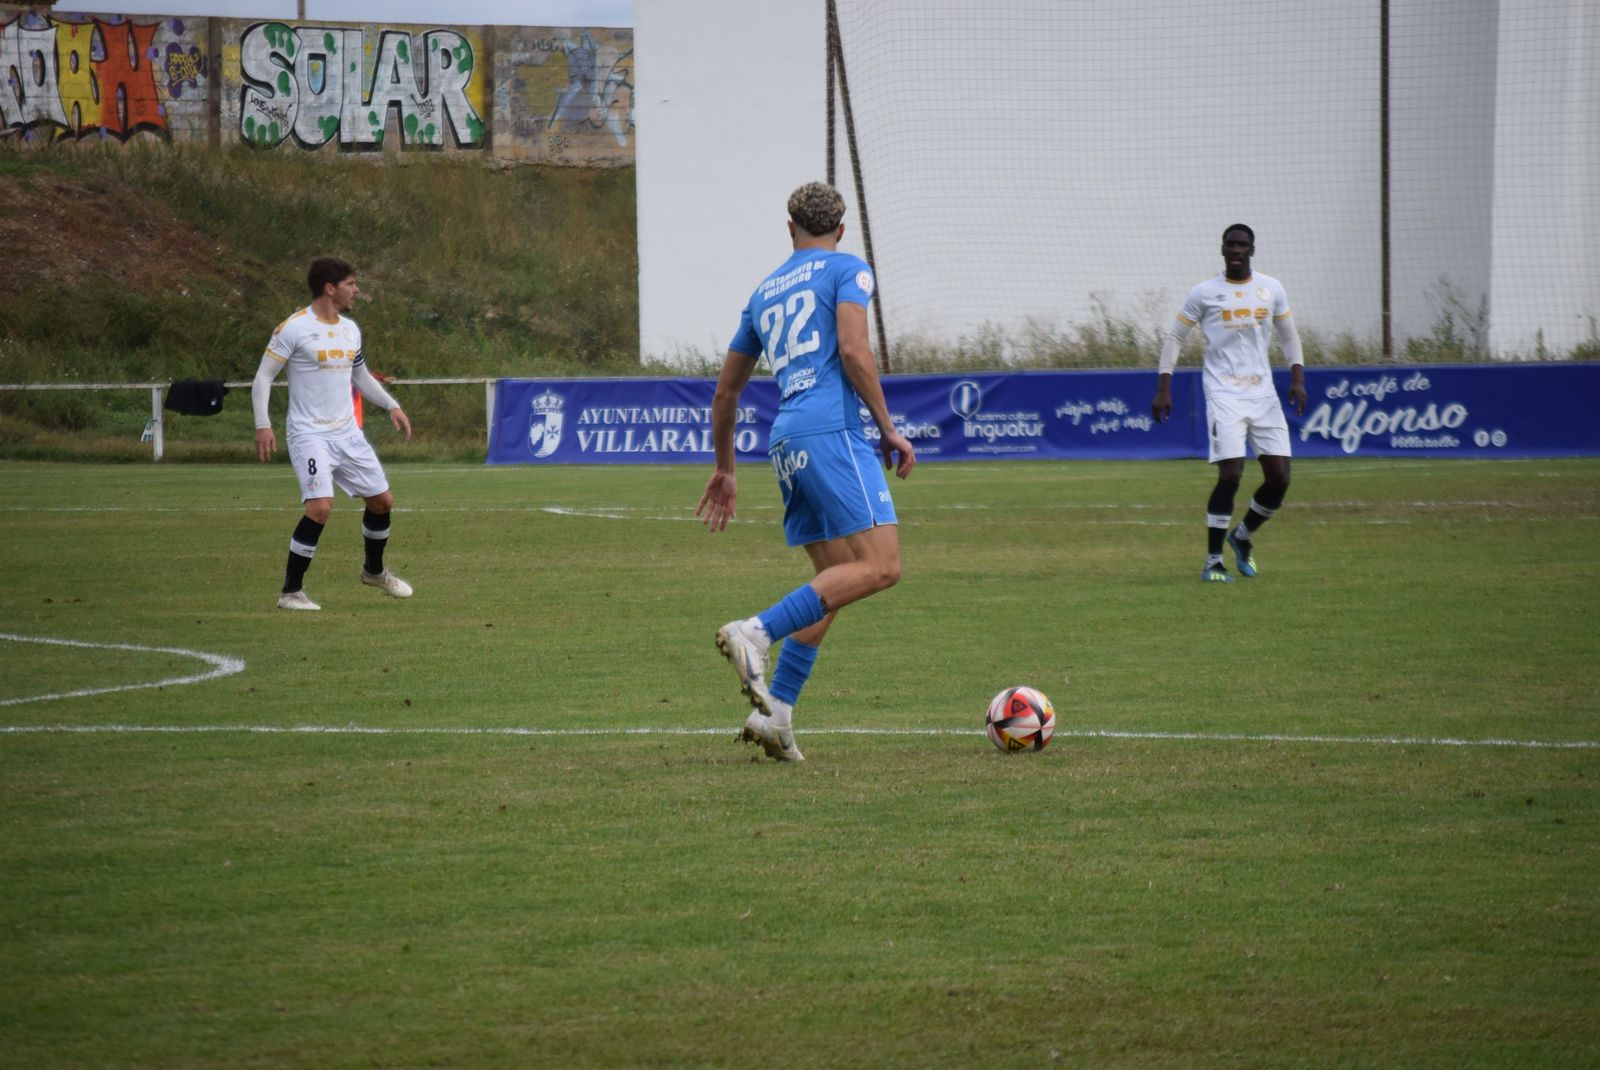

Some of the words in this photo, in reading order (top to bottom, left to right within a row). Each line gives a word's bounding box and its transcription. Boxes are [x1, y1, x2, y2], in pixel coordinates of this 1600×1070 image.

[239, 23, 484, 150] SOLAR
[760, 289, 820, 376] 22
[1326, 379, 1349, 399] el
[1353, 375, 1398, 402] café
[1404, 371, 1431, 391] de
[577, 408, 713, 424] AYUNTAMIENT
[1300, 399, 1469, 454] Alfonso
[576, 430, 758, 453] VILLARALO
[863, 422, 942, 440] saabria
[963, 420, 1045, 443] linguatur
[307, 458, 317, 475] 8
